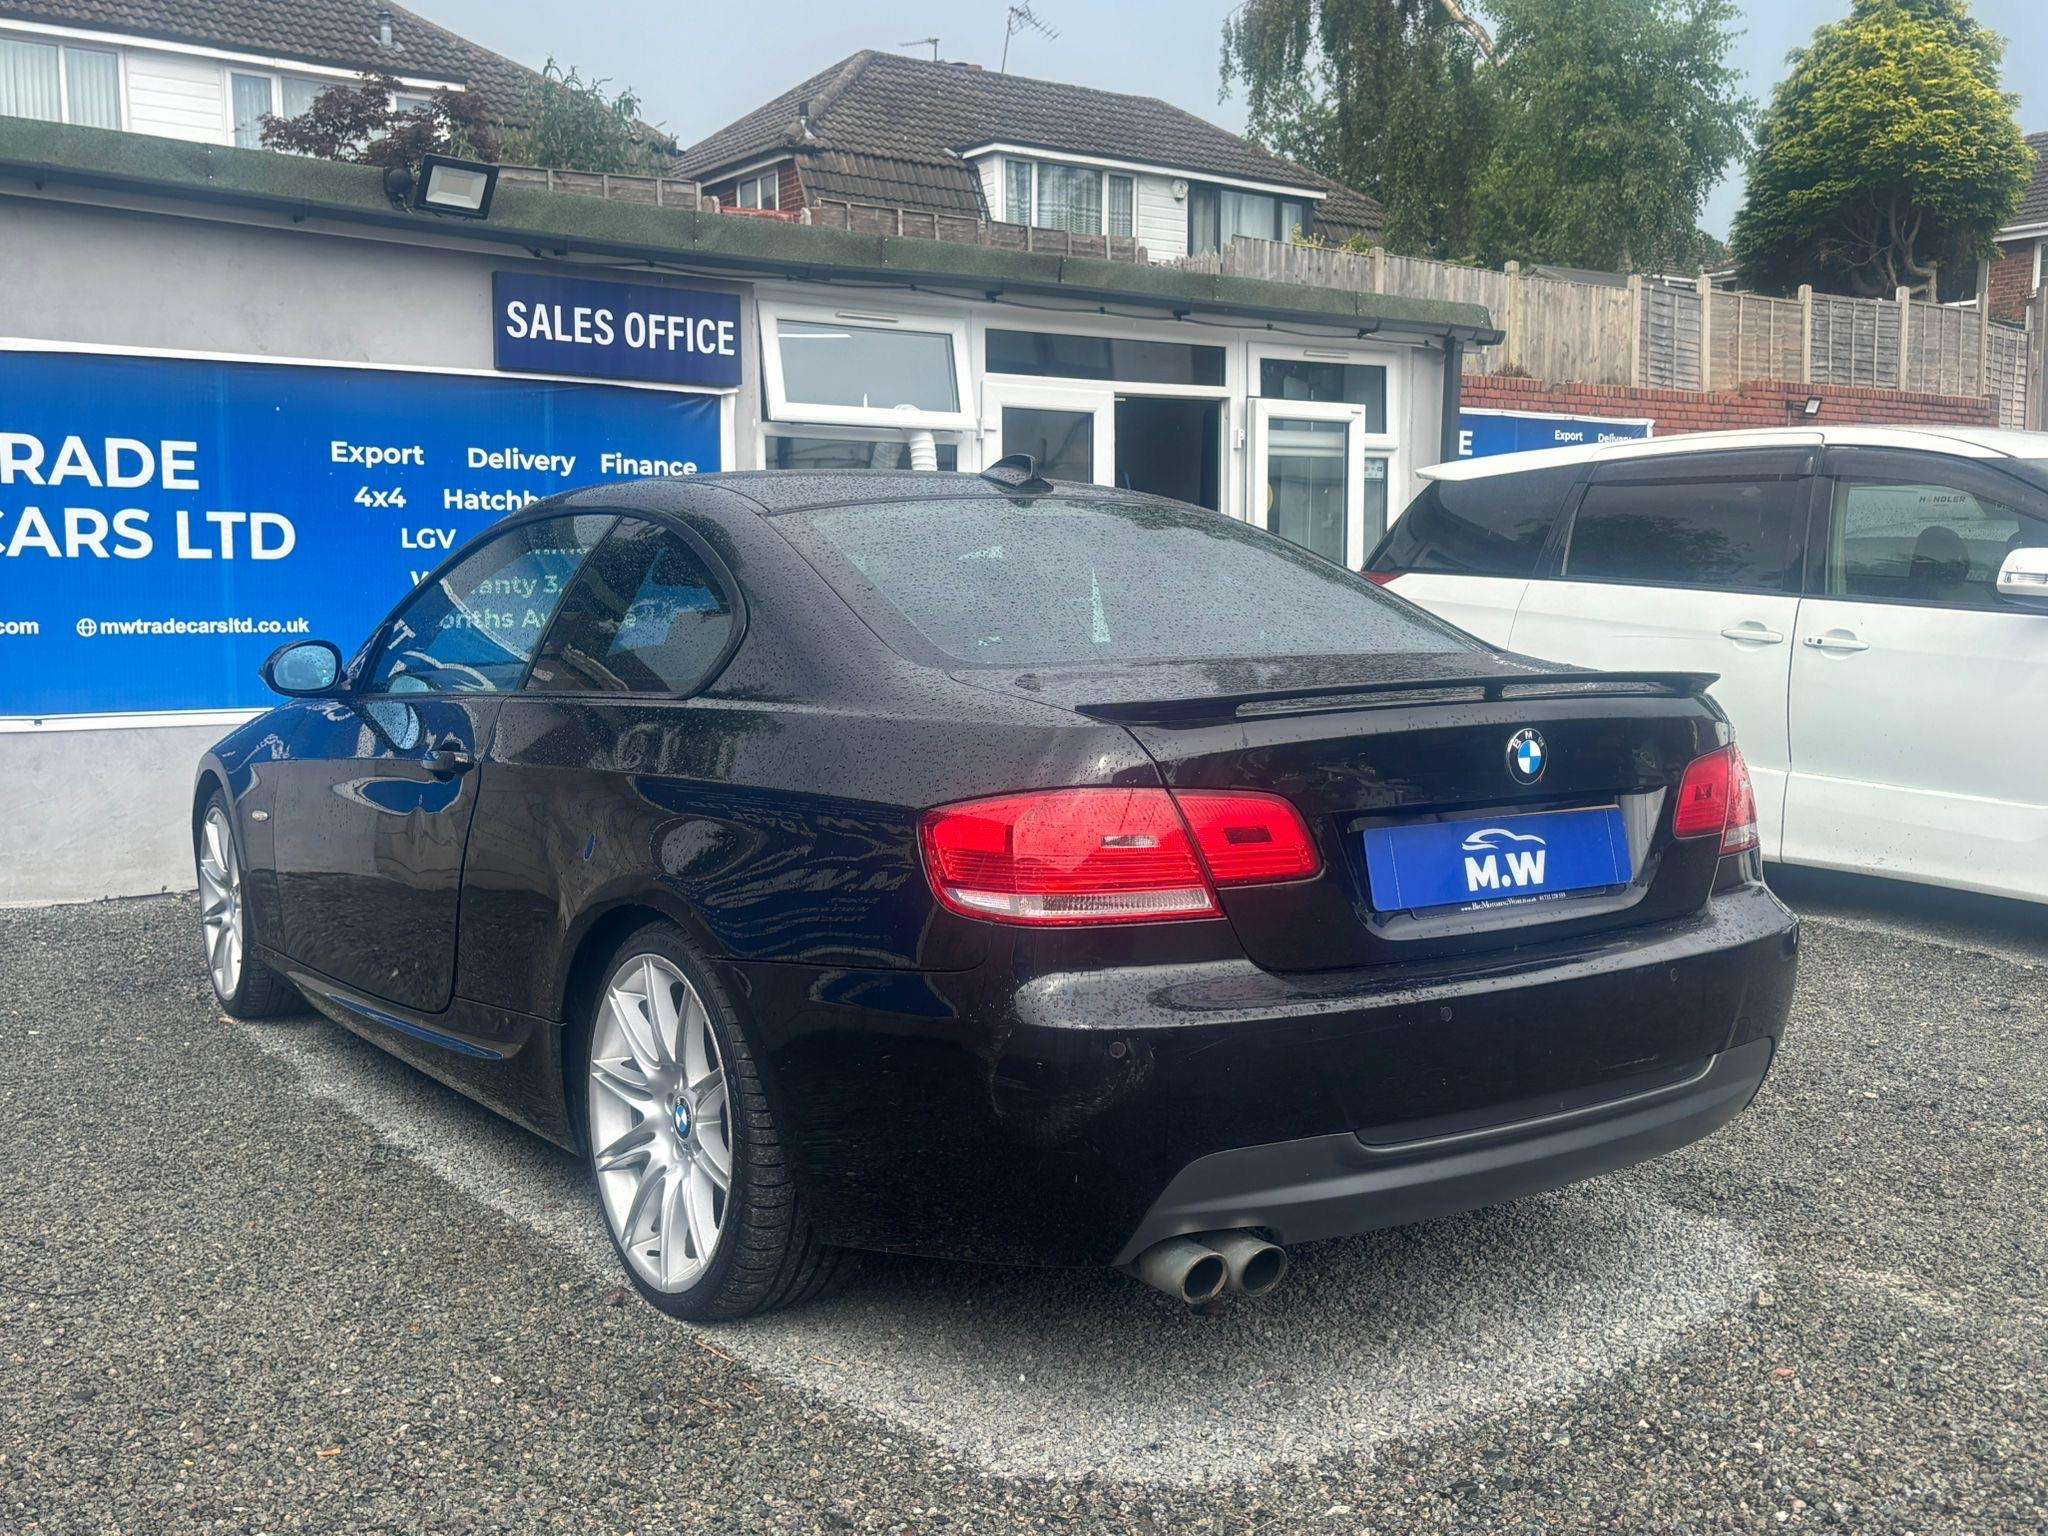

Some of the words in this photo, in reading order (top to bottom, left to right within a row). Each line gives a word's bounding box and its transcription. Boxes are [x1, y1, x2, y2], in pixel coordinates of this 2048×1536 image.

[506, 300, 615, 346] SALES
[624, 311, 735, 356] OFFICE
[1554, 430, 1583, 442] Export
[330, 441, 425, 469] Export
[467, 447, 576, 477] Delivery
[600, 452, 698, 476] Finance
[354, 486, 407, 508] 4x4
[0, 506, 153, 559] ARS
[176, 510, 296, 560] LTD
[401, 528, 457, 550] LGV
[100, 617, 310, 635] mwtradecarsltd.co.uk
[1464, 849, 1546, 892] M.W
